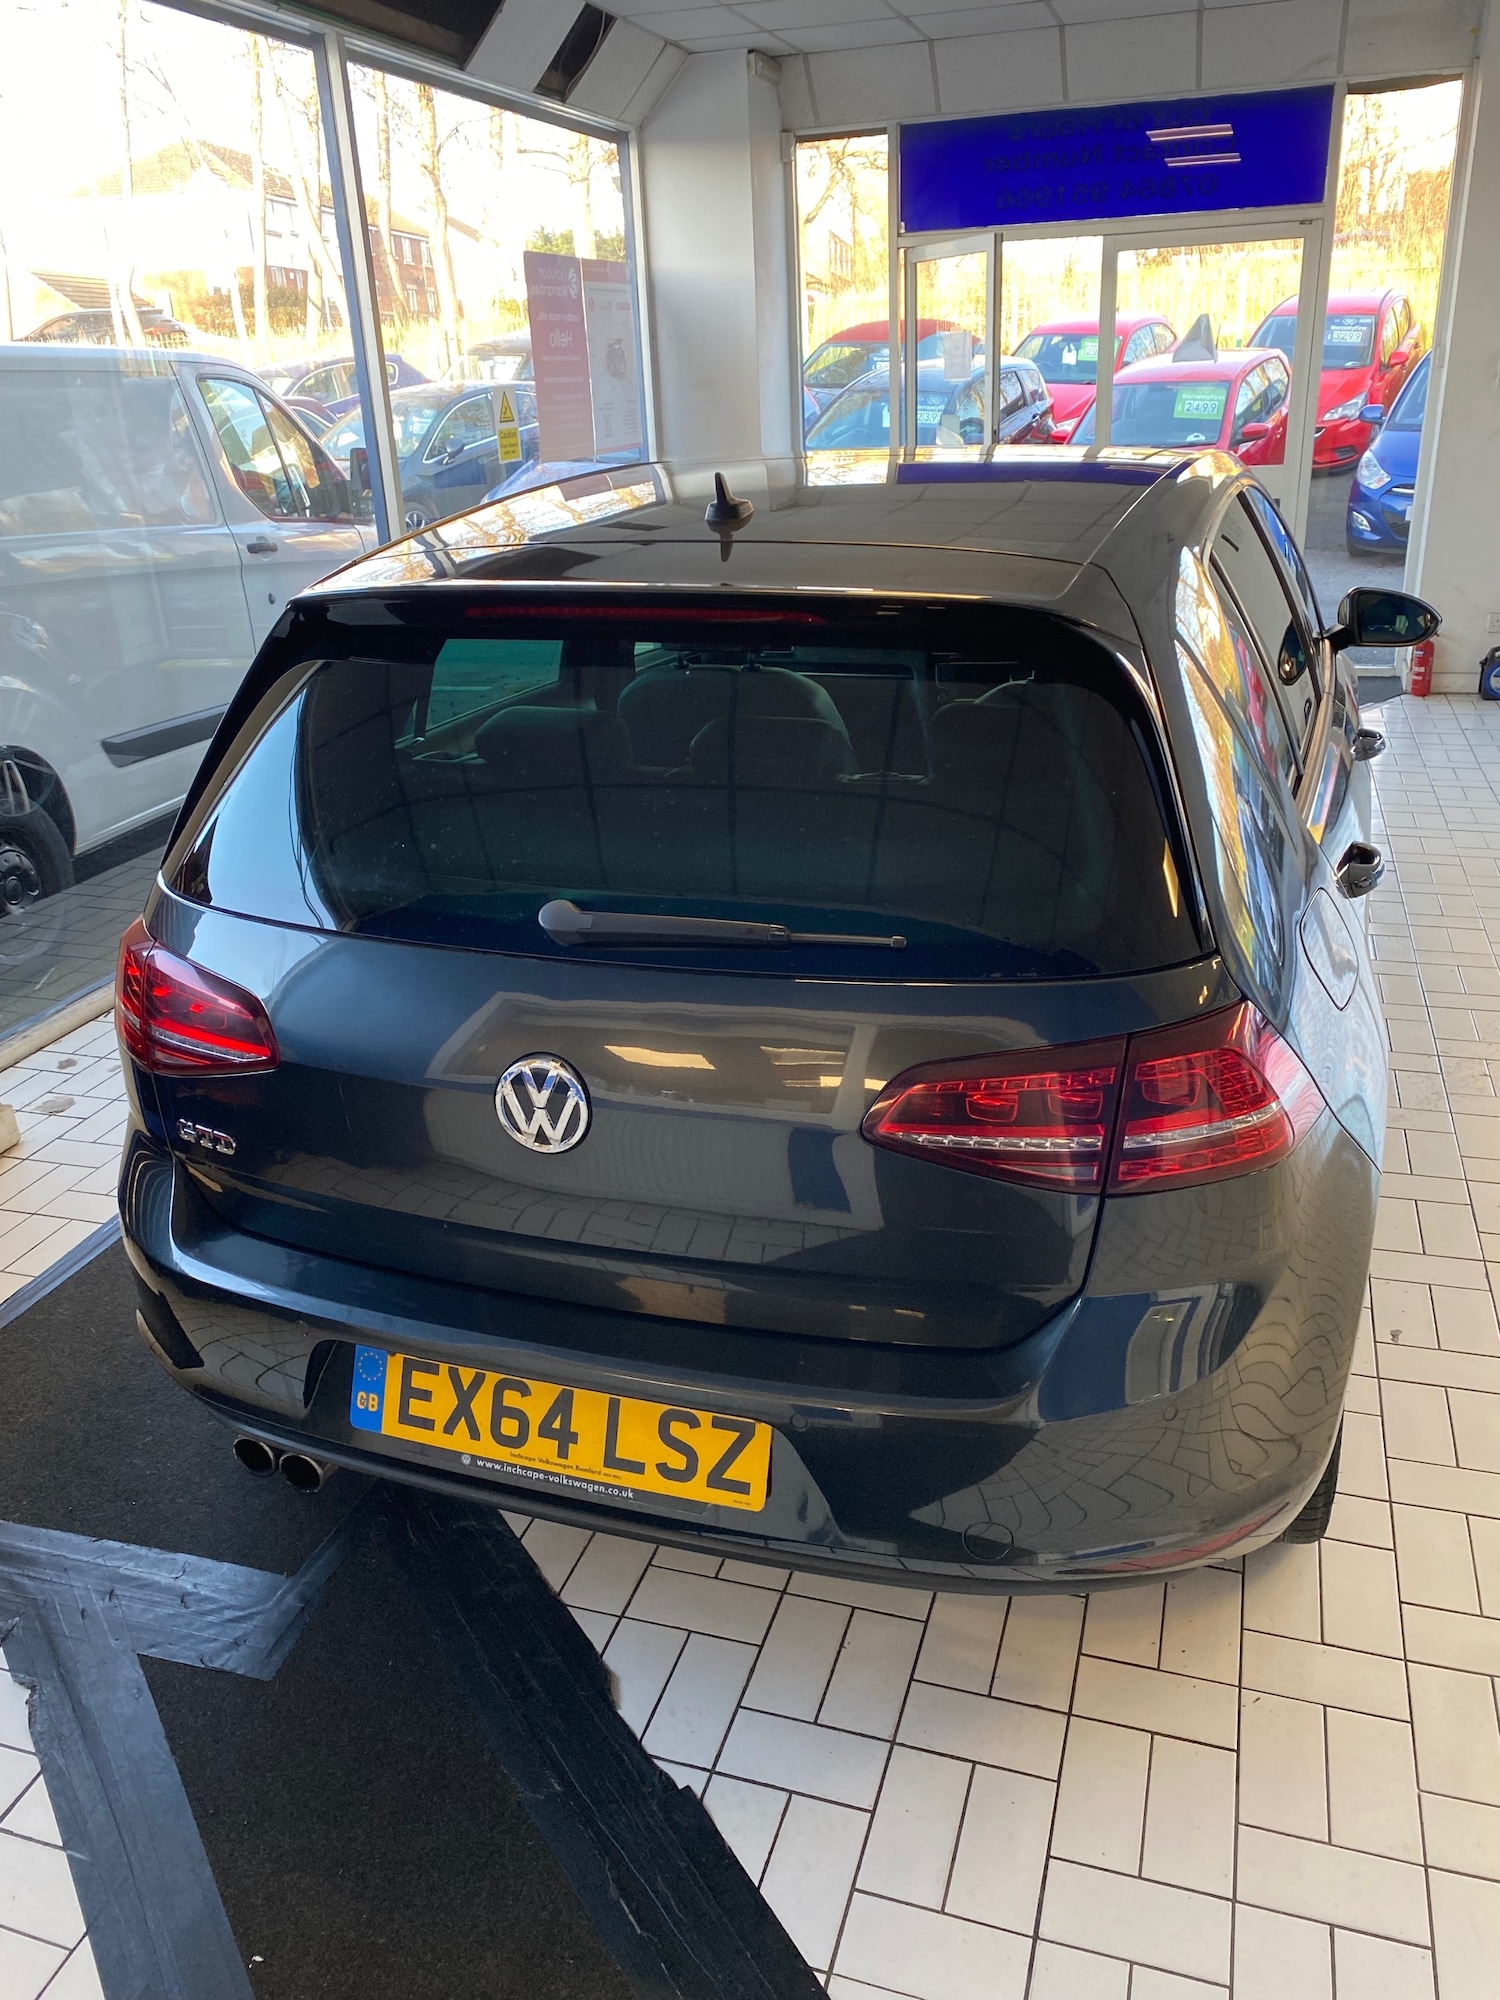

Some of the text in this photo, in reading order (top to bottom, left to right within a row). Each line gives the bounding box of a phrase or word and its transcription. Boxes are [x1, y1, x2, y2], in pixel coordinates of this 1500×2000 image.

[176, 1118, 236, 1155] GTD
[357, 1391, 379, 1412] GB
[398, 1356, 756, 1496] EX64 LSZ
[476, 1458, 634, 1499] www.inchcape-volkswagen.co.uk
[509, 1451, 536, 1462] Inchcape
[538, 1457, 574, 1470] Volkswagen
